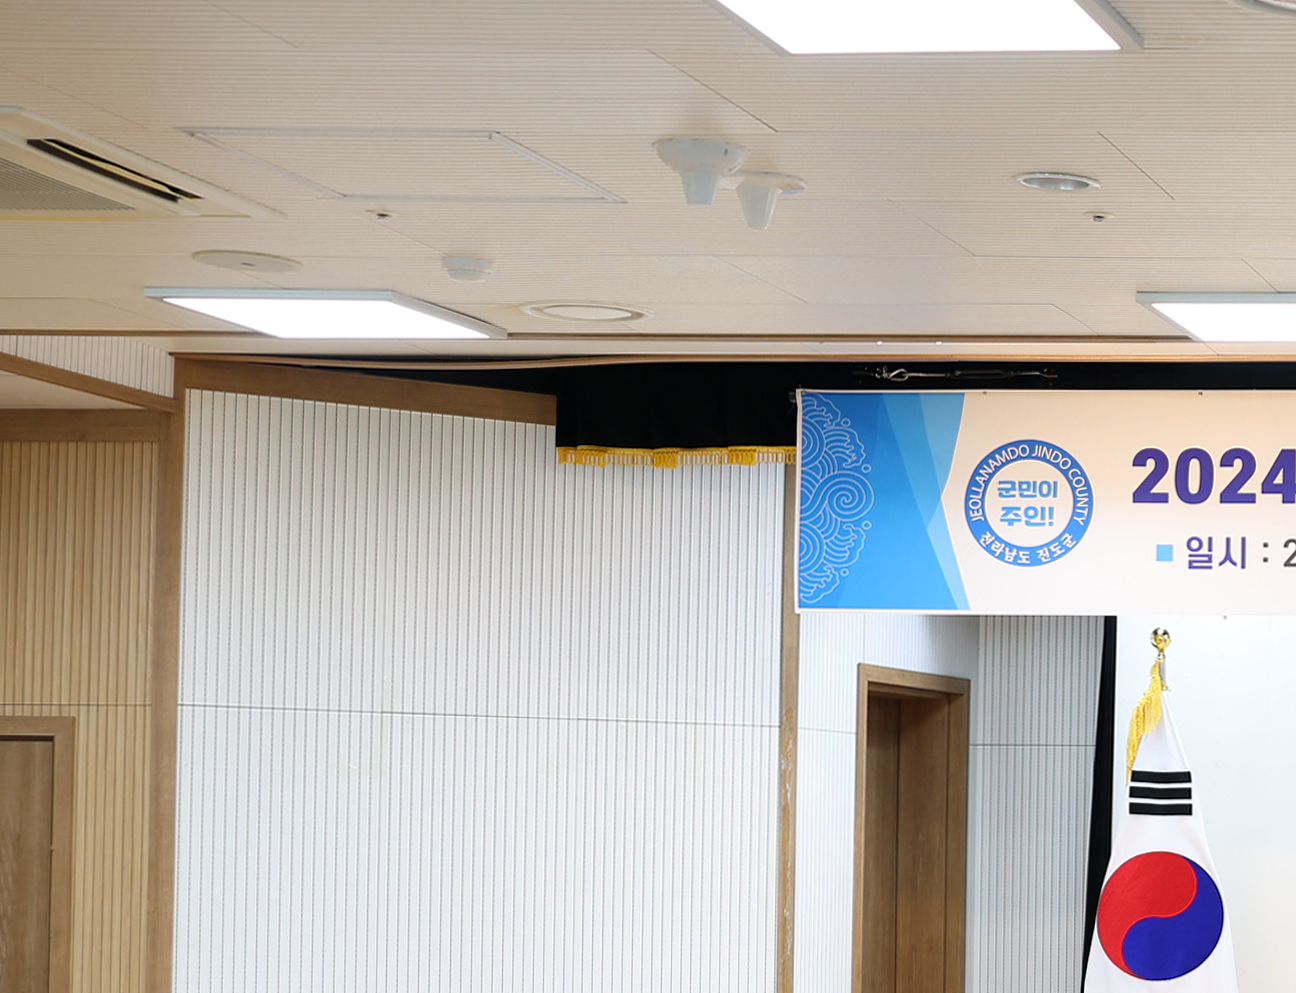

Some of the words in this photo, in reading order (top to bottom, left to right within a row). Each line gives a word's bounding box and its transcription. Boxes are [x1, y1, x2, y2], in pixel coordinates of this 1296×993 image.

[969, 444, 1030, 522] JEOLLANAMDO
[1032, 445, 1072, 470] JINDO
[1068, 468, 1090, 526] COUNTY
[997, 480, 1058, 498] 군민이
[1000, 506, 1054, 527] 주인!
[1186, 536, 1246, 569] 일시
